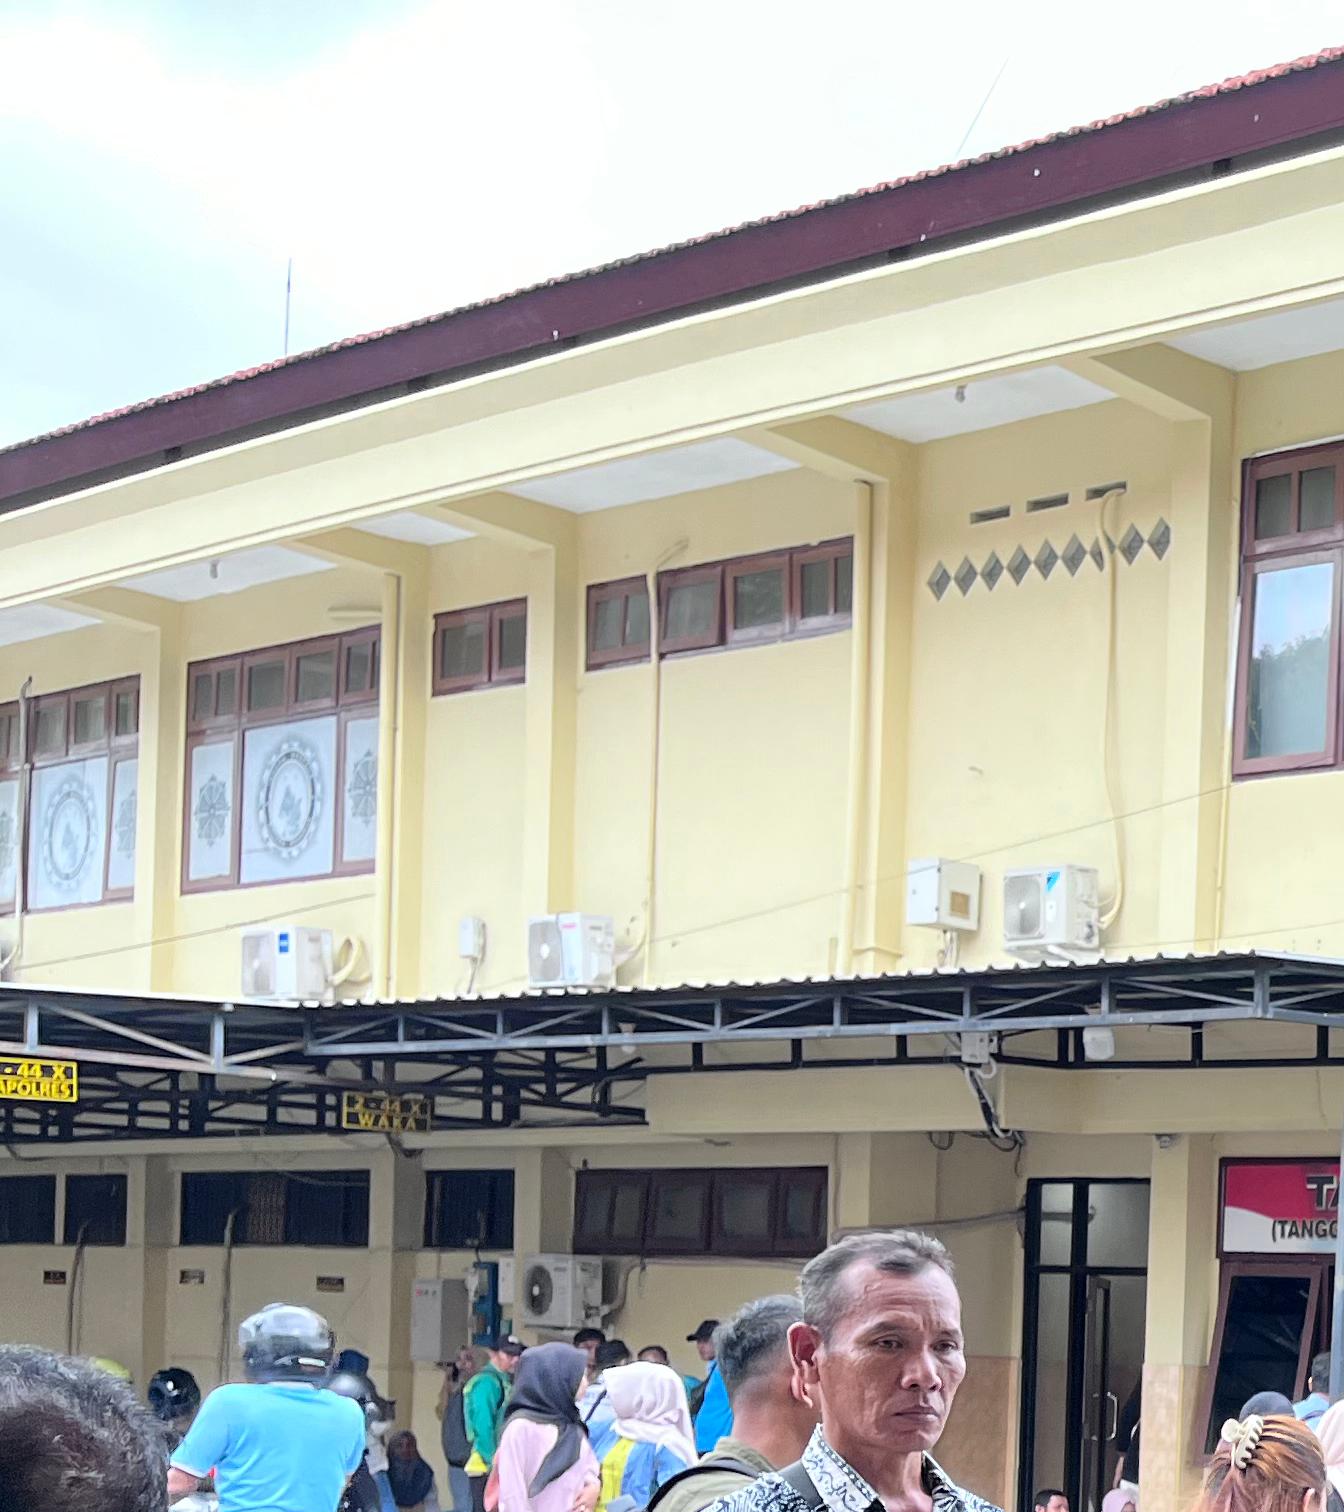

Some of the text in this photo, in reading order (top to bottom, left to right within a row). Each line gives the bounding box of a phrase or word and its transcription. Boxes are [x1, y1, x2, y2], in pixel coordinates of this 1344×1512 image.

[17, 1063, 43, 1079] 44
[52, 1064, 66, 1081] X
[358, 1111, 417, 1134] WAKA
